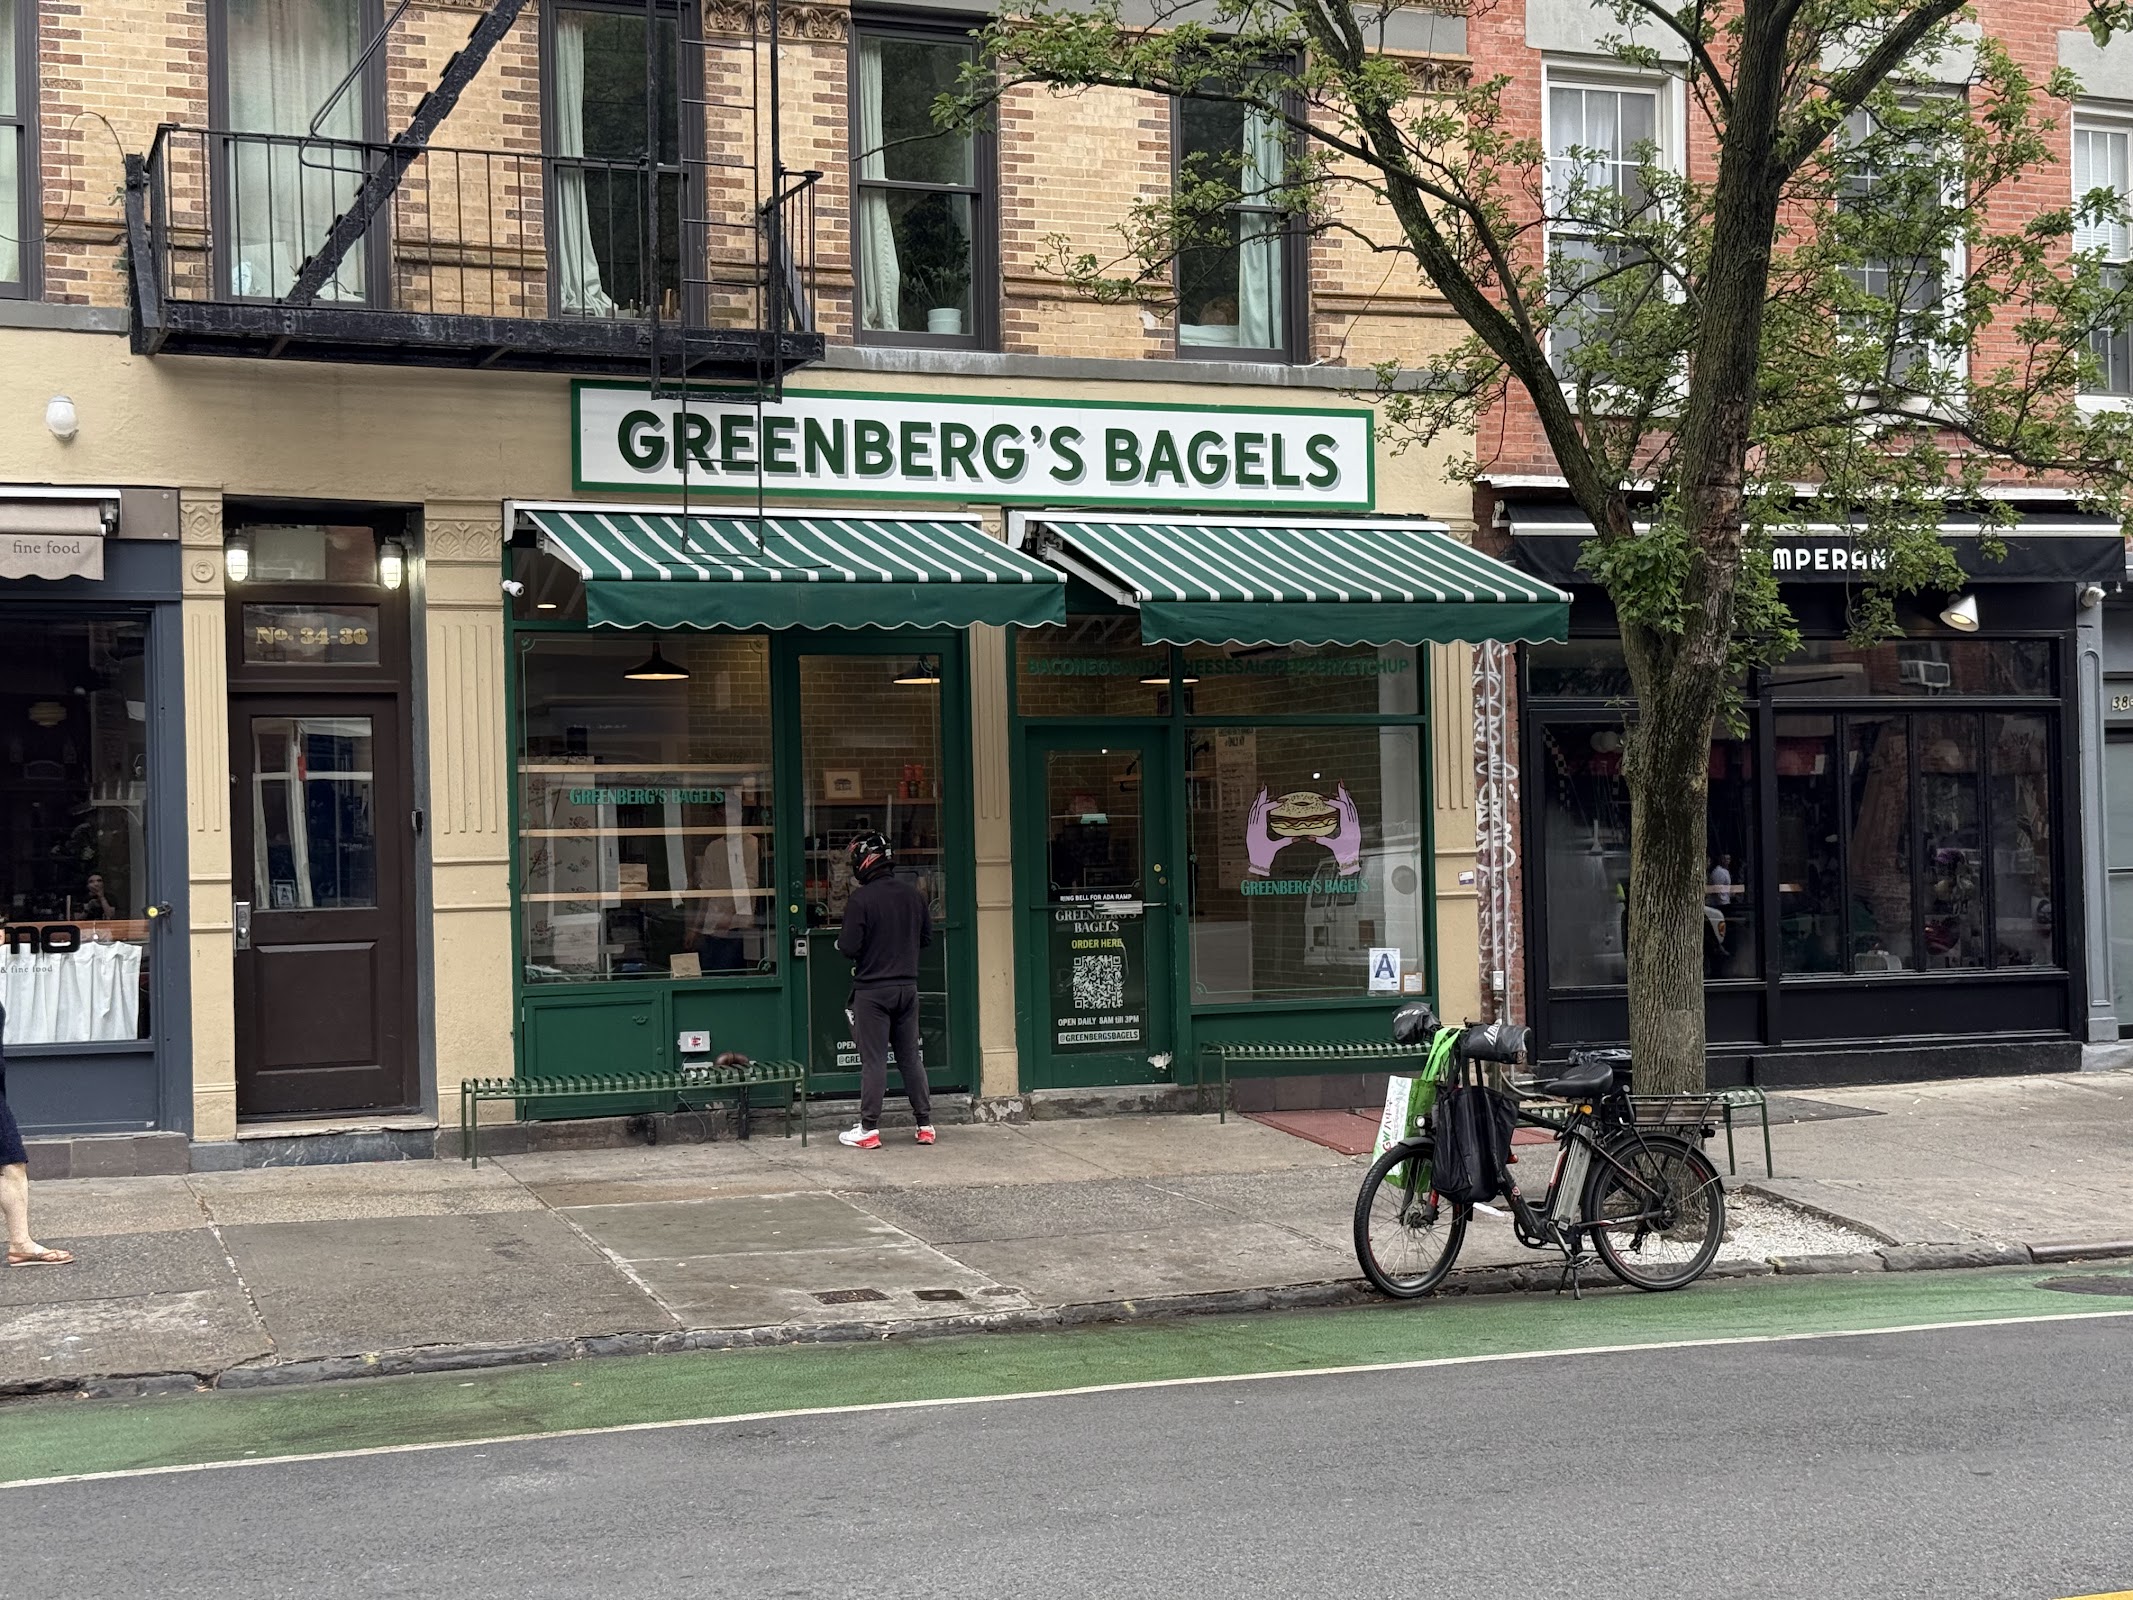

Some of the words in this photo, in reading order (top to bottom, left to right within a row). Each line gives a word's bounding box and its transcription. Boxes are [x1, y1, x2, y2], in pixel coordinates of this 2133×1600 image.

[617, 409, 1086, 485] GREENBERG'S
[1105, 427, 1341, 491] BAGELS
[13, 540, 41, 554] fine
[47, 540, 80, 554] food
[256, 626, 294, 645] No.
[300, 627, 368, 645] 34-36
[569, 786, 667, 805] GREENBERG'S
[672, 786, 725, 804] BAGELS
[1240, 879, 1322, 896] GREENBERG'S
[1324, 878, 1369, 894] BAGELS
[1074, 920, 1120, 933] BAGELS
[1071, 939, 1100, 949] ORDER
[1100, 938, 1122, 948] HERE
[32, 965, 53, 973] food
[1374, 953, 1395, 978] A
[1058, 1018, 1077, 1026] OPEN
[1077, 1017, 1097, 1026] DAILY
[1098, 1016, 1114, 1025] 8AM
[1124, 1015, 1139, 1024] 3PM
[836, 1041, 857, 1050] OPEN
